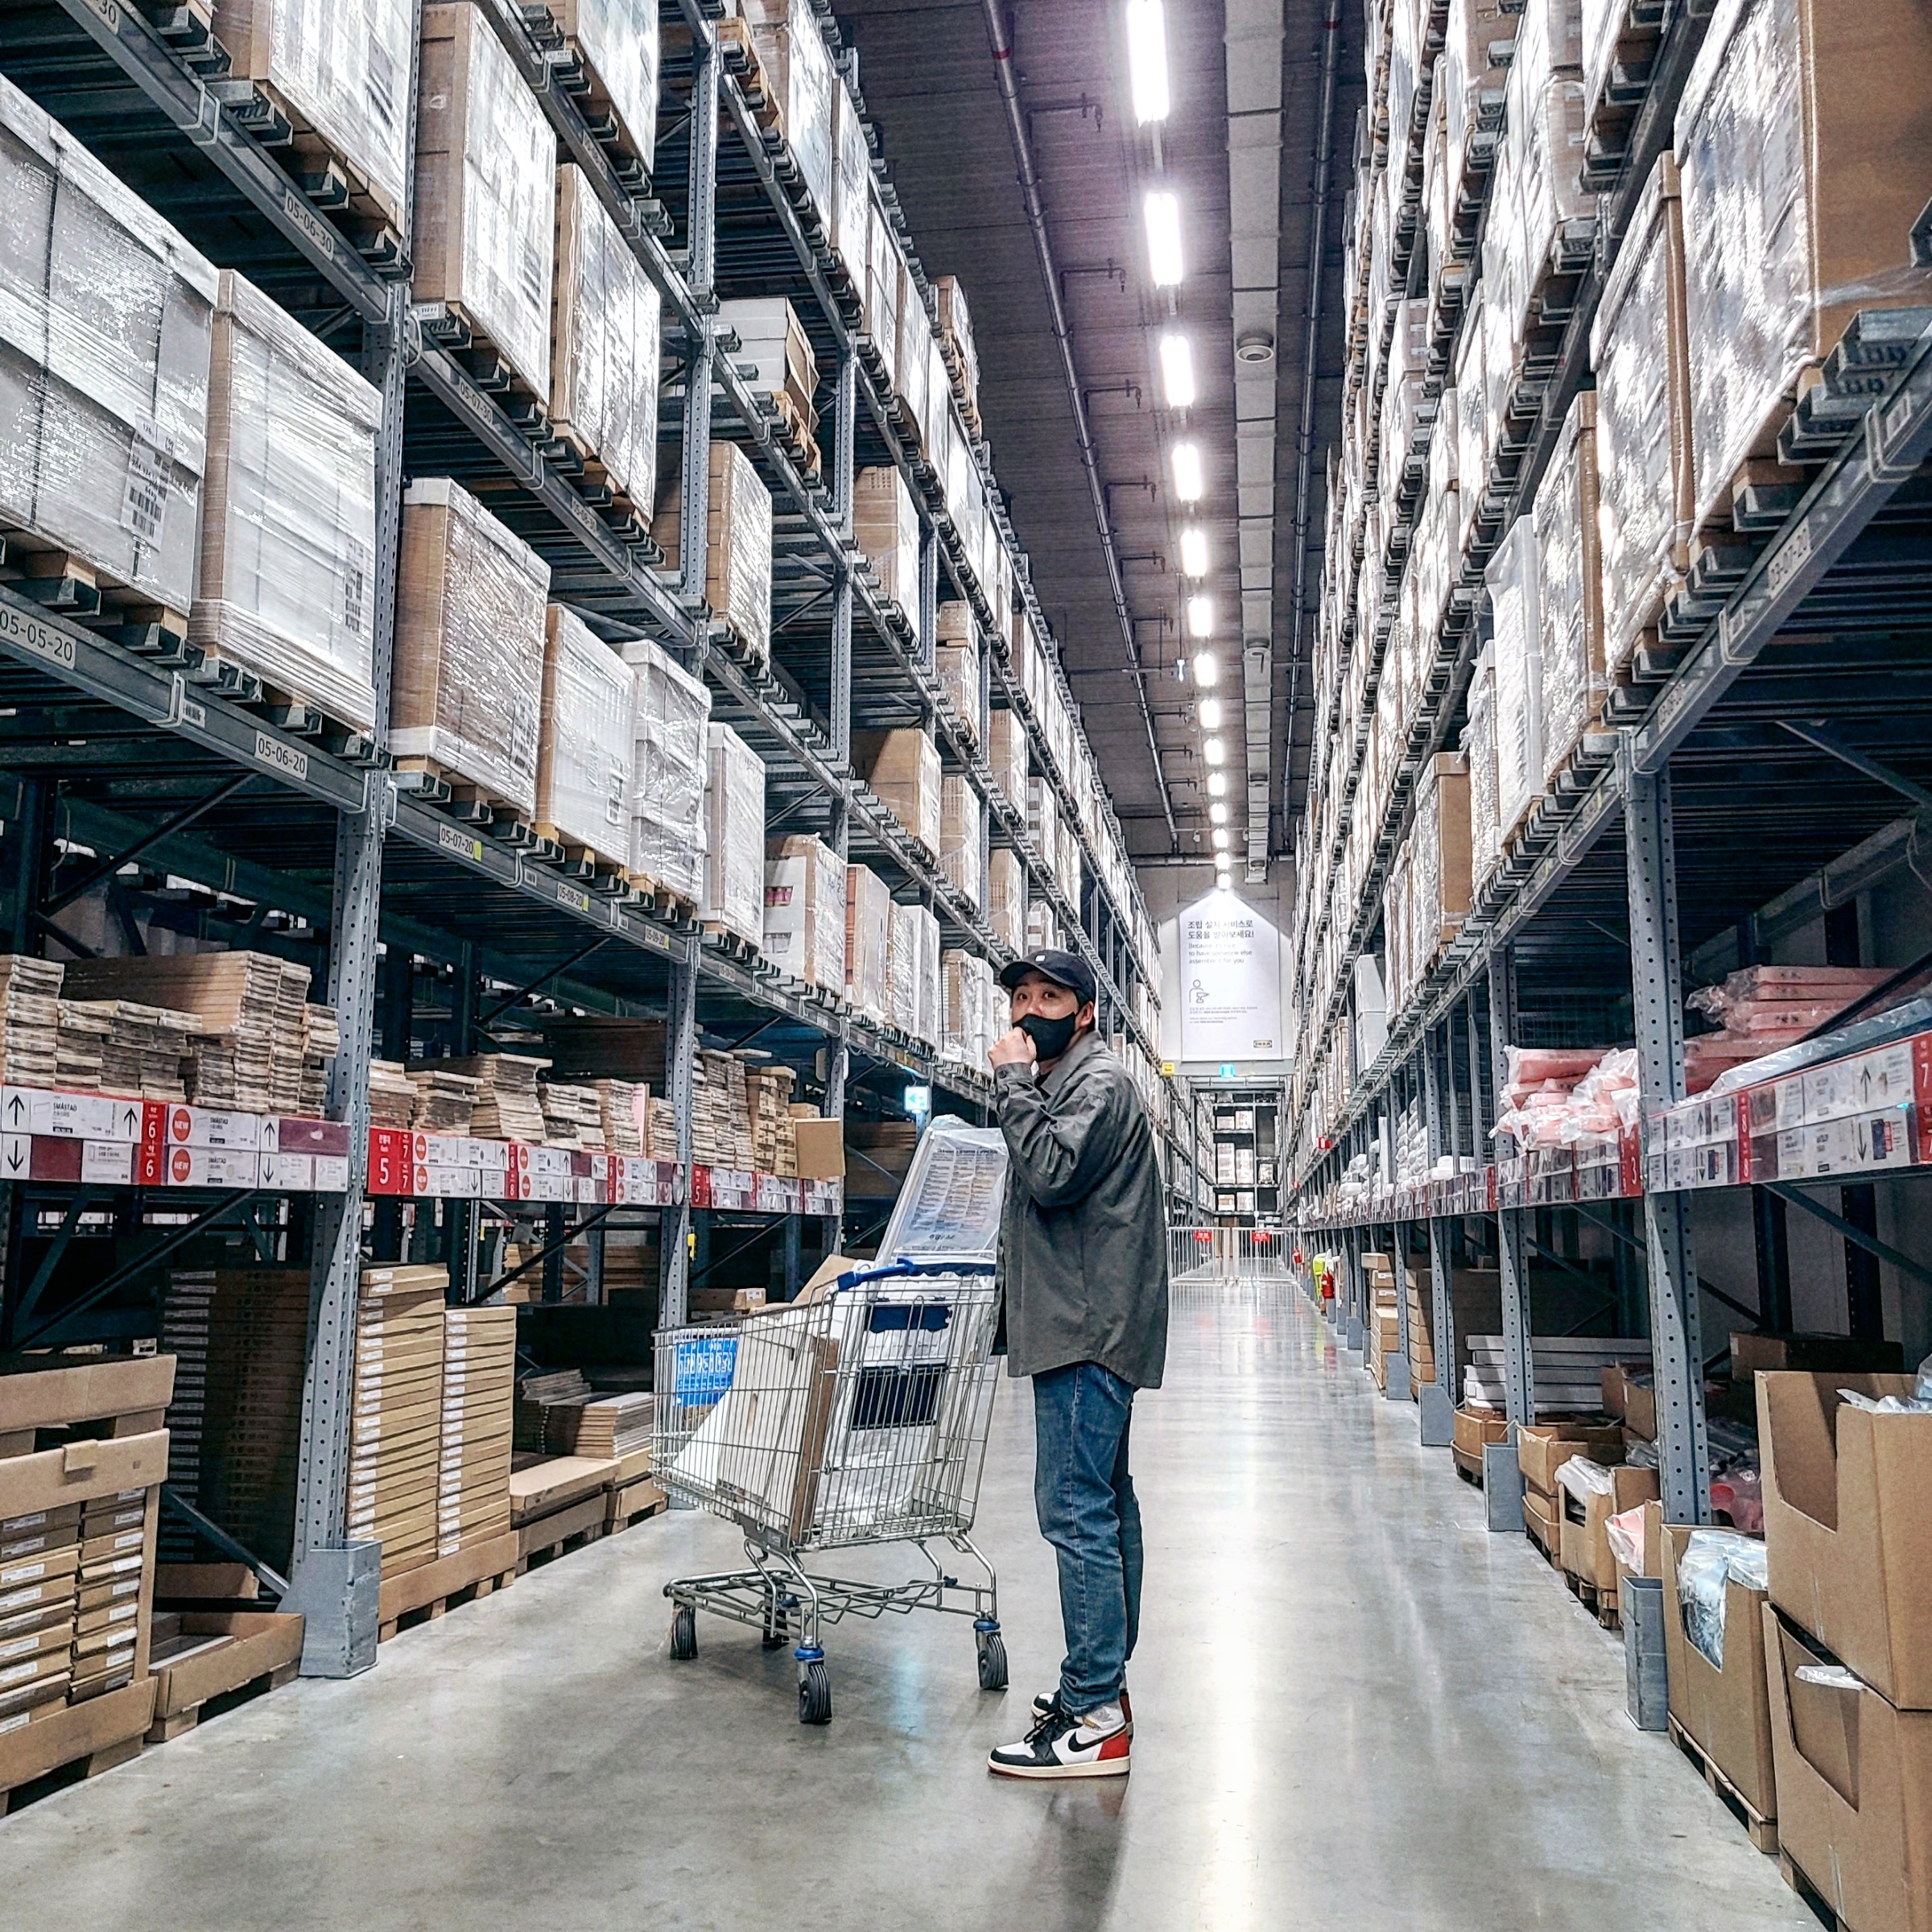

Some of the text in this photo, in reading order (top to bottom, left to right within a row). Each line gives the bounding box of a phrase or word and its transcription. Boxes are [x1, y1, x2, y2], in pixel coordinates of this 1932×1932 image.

[287, 196, 332, 253] 05-06-30
[460, 382, 491, 423] 05-07-30
[0, 609, 72, 662] 05-05-20
[258, 737, 306, 774] 05-06-20
[440, 830, 473, 854] 05-07-20
[558, 885, 583, 907] 05-08-20
[1187, 921, 1203, 929] 조립
[1187, 931, 1211, 939] 도움을
[1921, 1063, 1929, 1088] 7
[148, 1121, 156, 1138] 6
[174, 1121, 189, 1129] NEW
[1741, 1113, 1747, 1133] 8
[402, 1145, 408, 1158] 7
[146, 1160, 154, 1177] 6
[174, 1161, 189, 1170] NEW
[379, 1157, 389, 1184] 5
[510, 1156, 515, 1168] 8
[609, 1165, 613, 1176] 9
[1631, 1156, 1637, 1185] 3
[1744, 1158, 1749, 1178] 8
[402, 1175, 408, 1188] 7
[510, 1184, 514, 1195] 8
[608, 1189, 613, 1199] 9
[696, 1186, 700, 1203] 5
